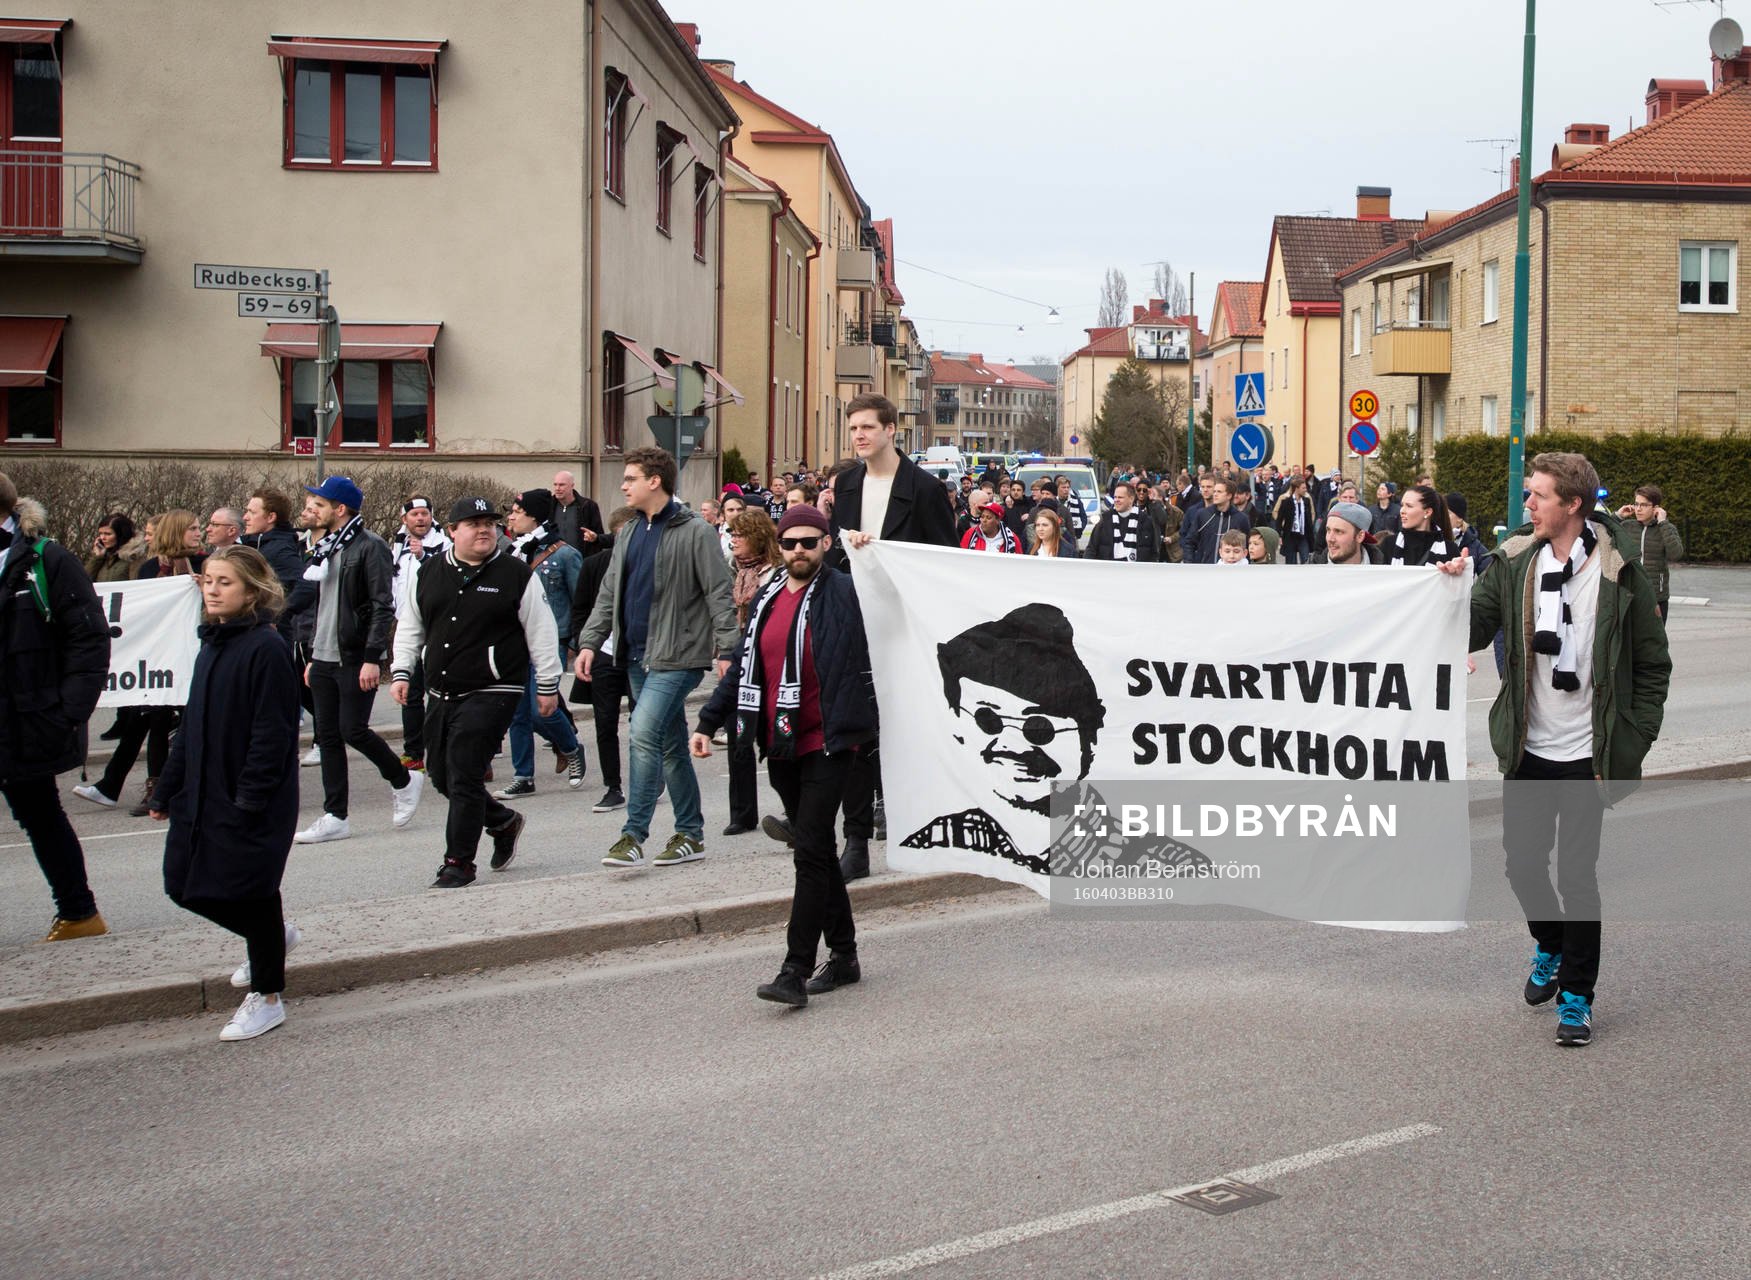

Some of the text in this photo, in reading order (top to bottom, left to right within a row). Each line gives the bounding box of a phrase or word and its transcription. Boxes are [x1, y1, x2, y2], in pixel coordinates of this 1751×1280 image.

[202, 269, 311, 291] Rudbecksg.
[1355, 397, 1375, 413] 30
[1126, 658, 1452, 711] SVARTVITA I
[1132, 722, 1450, 783] STOCKHOLM
